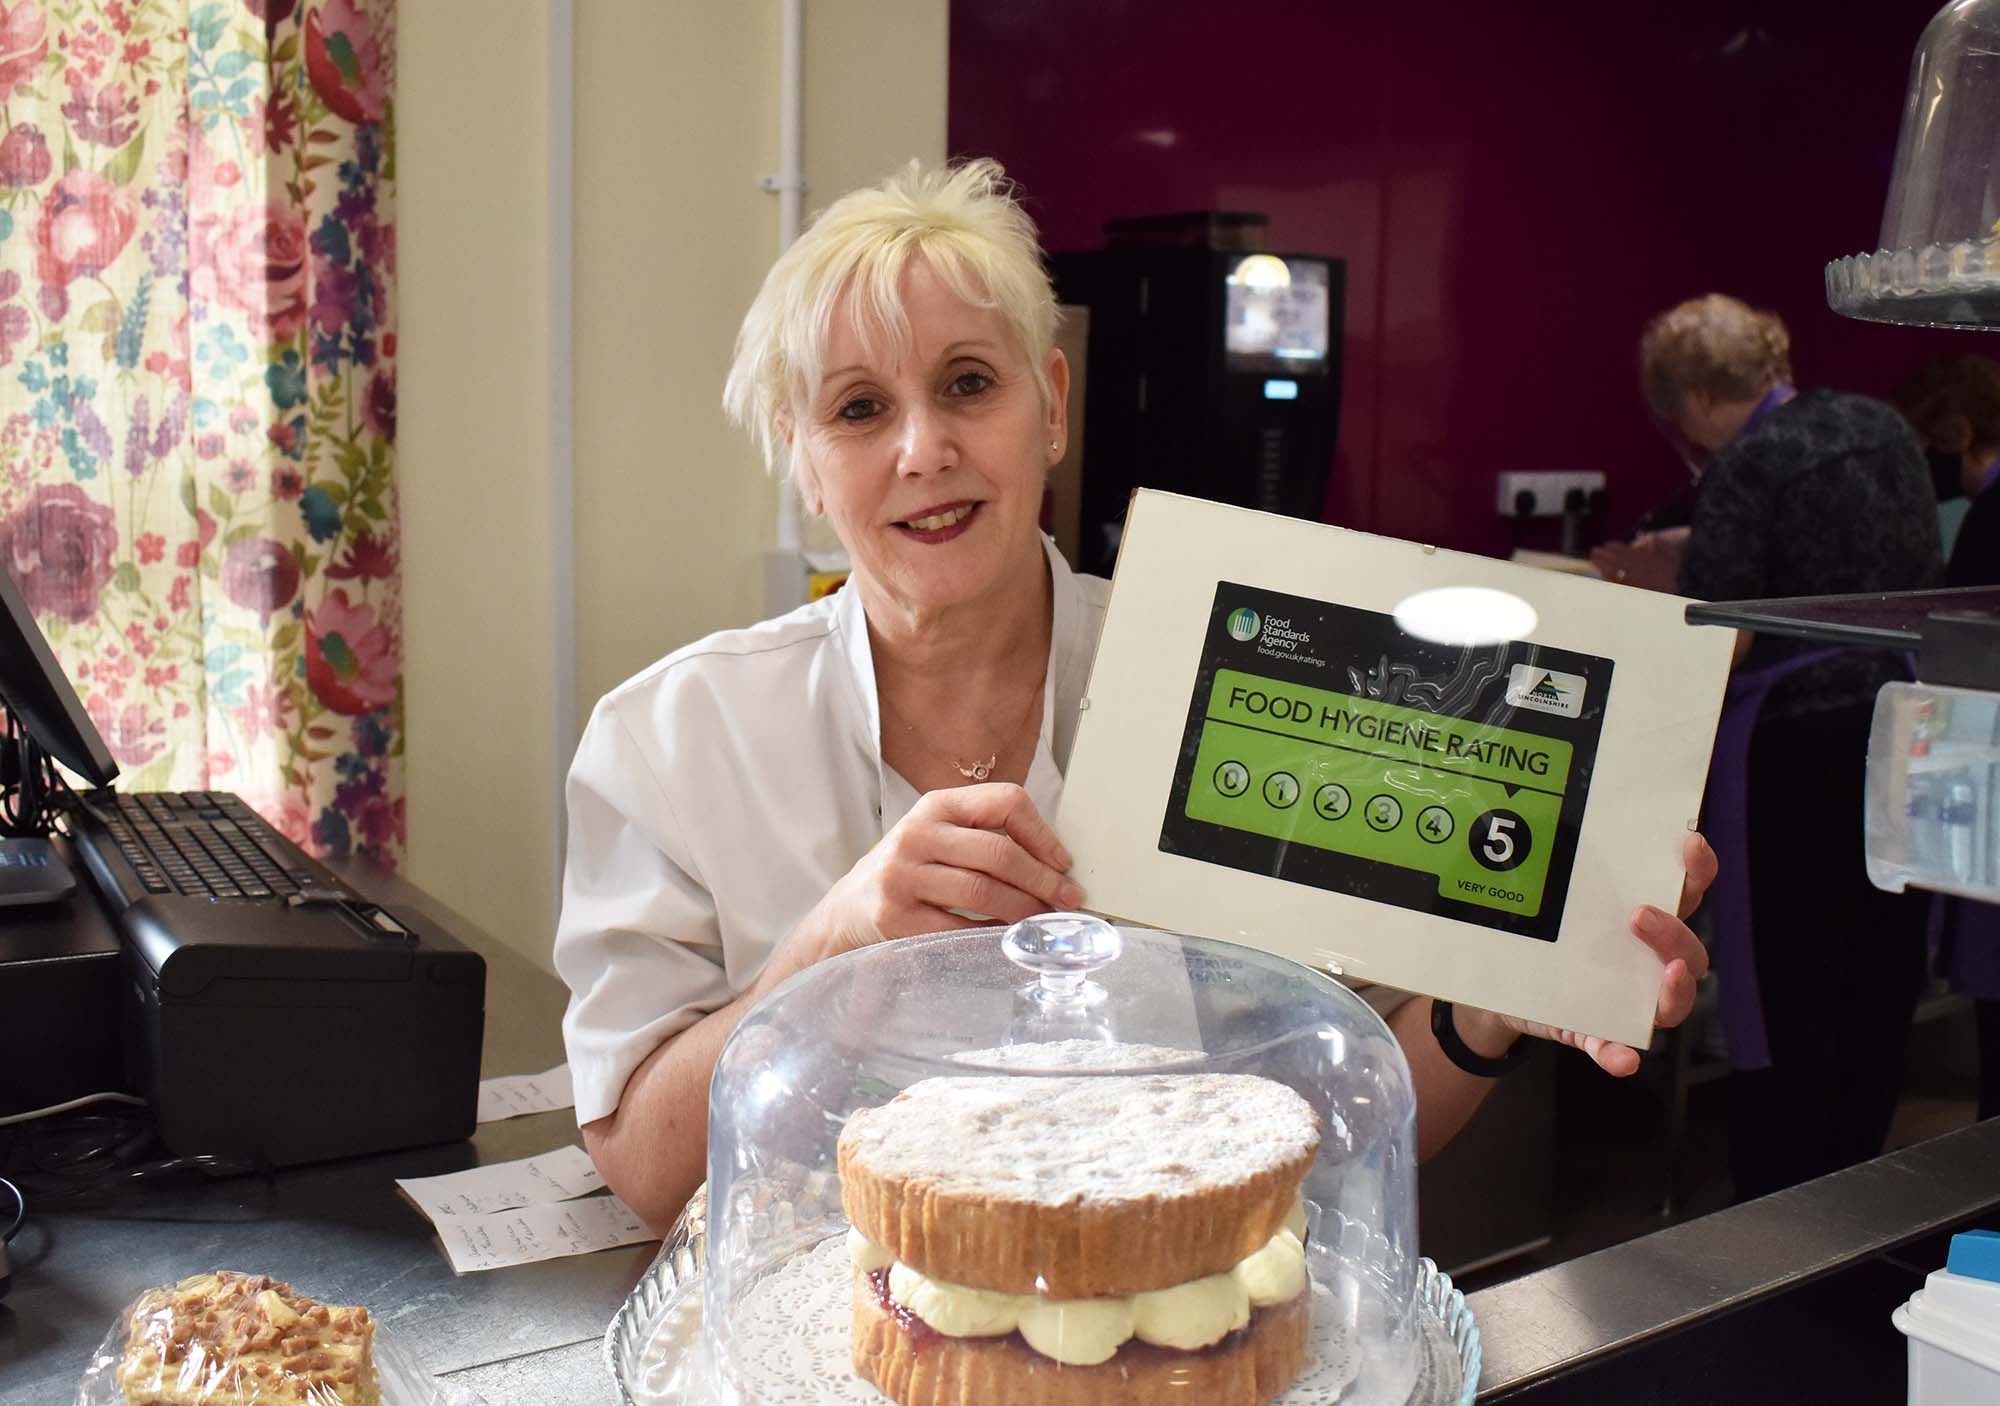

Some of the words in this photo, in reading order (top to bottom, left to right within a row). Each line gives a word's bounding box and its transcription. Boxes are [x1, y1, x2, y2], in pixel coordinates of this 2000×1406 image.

[1264, 615, 1291, 629] Food
[1260, 633, 1298, 651] Agency
[1262, 624, 1311, 642] Standards
[1257, 645, 1326, 667] food.gov.uk/ratings
[1517, 694, 1570, 709] LINCOLNSHIRE
[1532, 690, 1559, 701] NORTH
[1228, 687, 1313, 723] FOOD
[1319, 706, 1441, 752] HYGIENE
[1445, 733, 1551, 776] RATING
[1224, 768, 1239, 790] 0
[1323, 790, 1340, 813] 2
[1374, 802, 1392, 824] 3
[1425, 814, 1442, 836] 4
[1482, 816, 1517, 863] 5
[1457, 879, 1487, 894] VERY
[1488, 887, 1525, 903] GOOD
